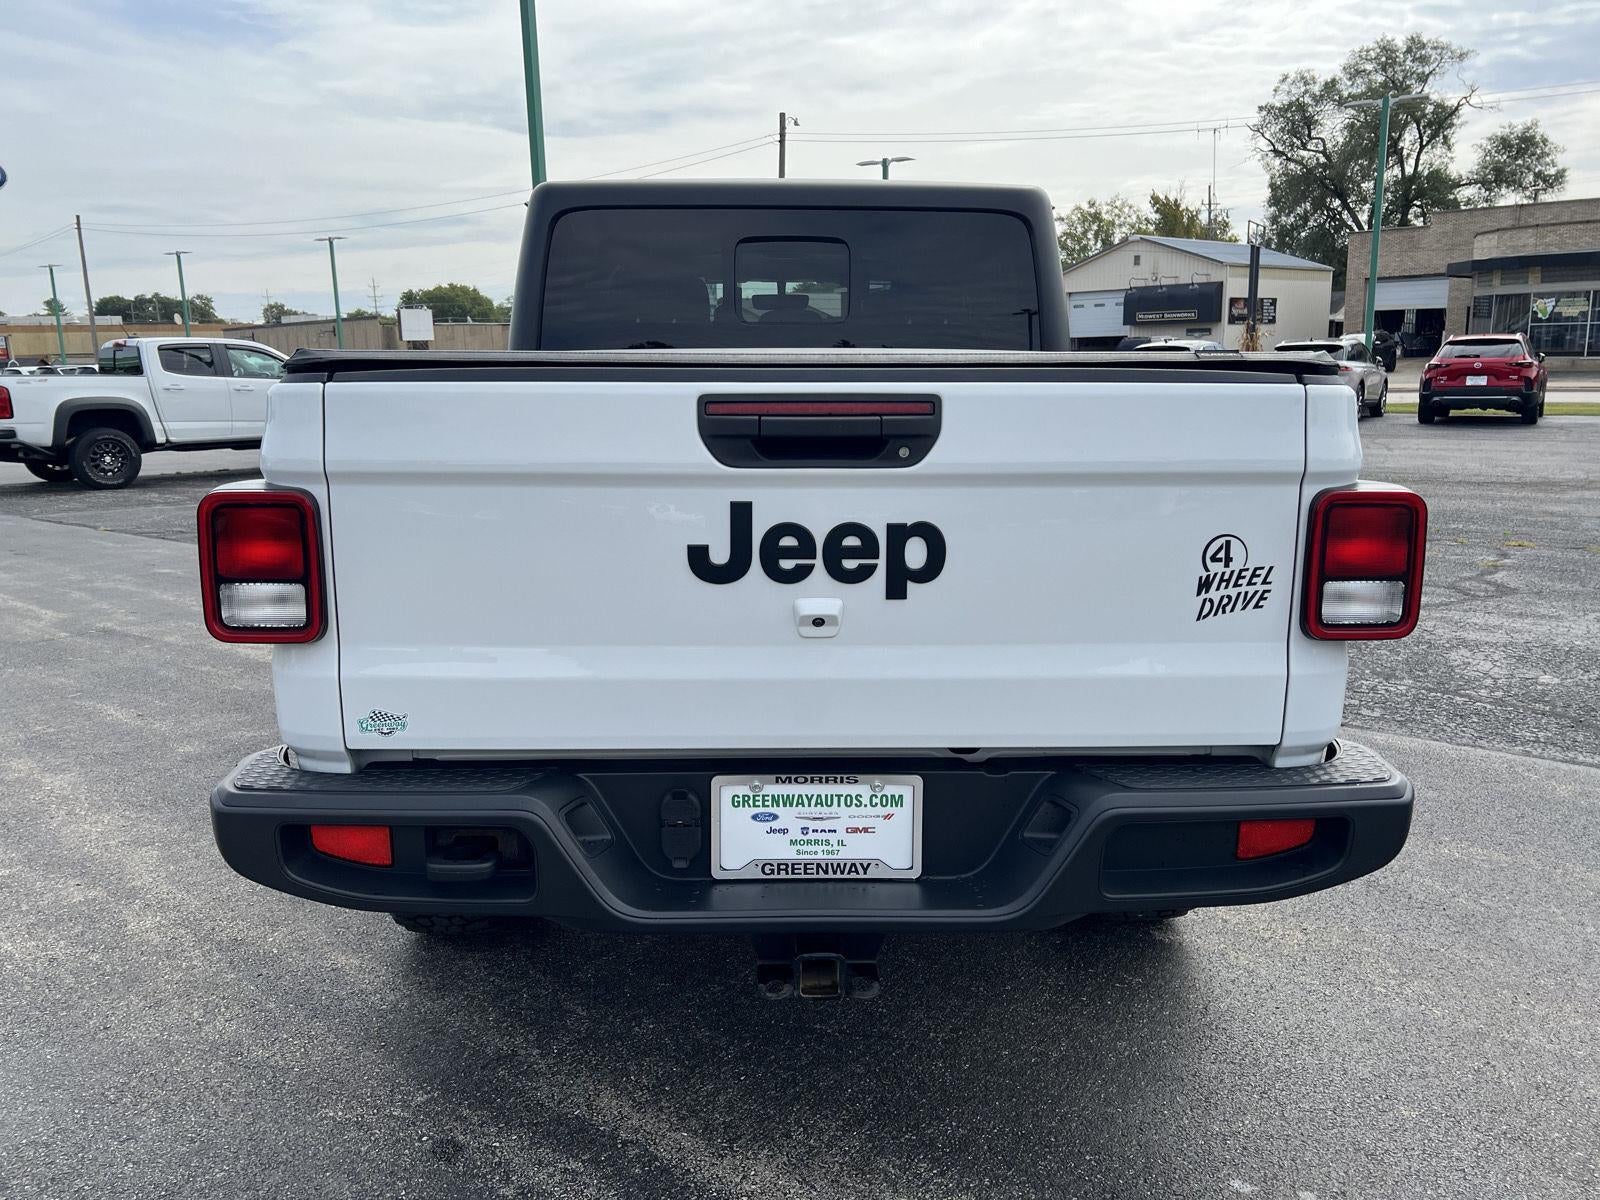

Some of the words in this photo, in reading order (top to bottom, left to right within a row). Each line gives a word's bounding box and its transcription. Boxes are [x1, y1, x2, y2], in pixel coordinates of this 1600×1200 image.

[687, 500, 947, 600] Jeep
[1209, 539, 1233, 568] 4
[1196, 565, 1275, 597] WHEEL
[1196, 589, 1272, 622] DRIVE
[358, 719, 406, 732] Greenway
[775, 775, 859, 784] MORRIS
[731, 793, 904, 808] GREENWAYAUTOS.COM
[756, 813, 773, 822] Ford
[766, 827, 789, 835] Jeep
[789, 839, 834, 847] MORRIS,
[837, 839, 847, 847] IL
[760, 862, 872, 876] GREENWAY
